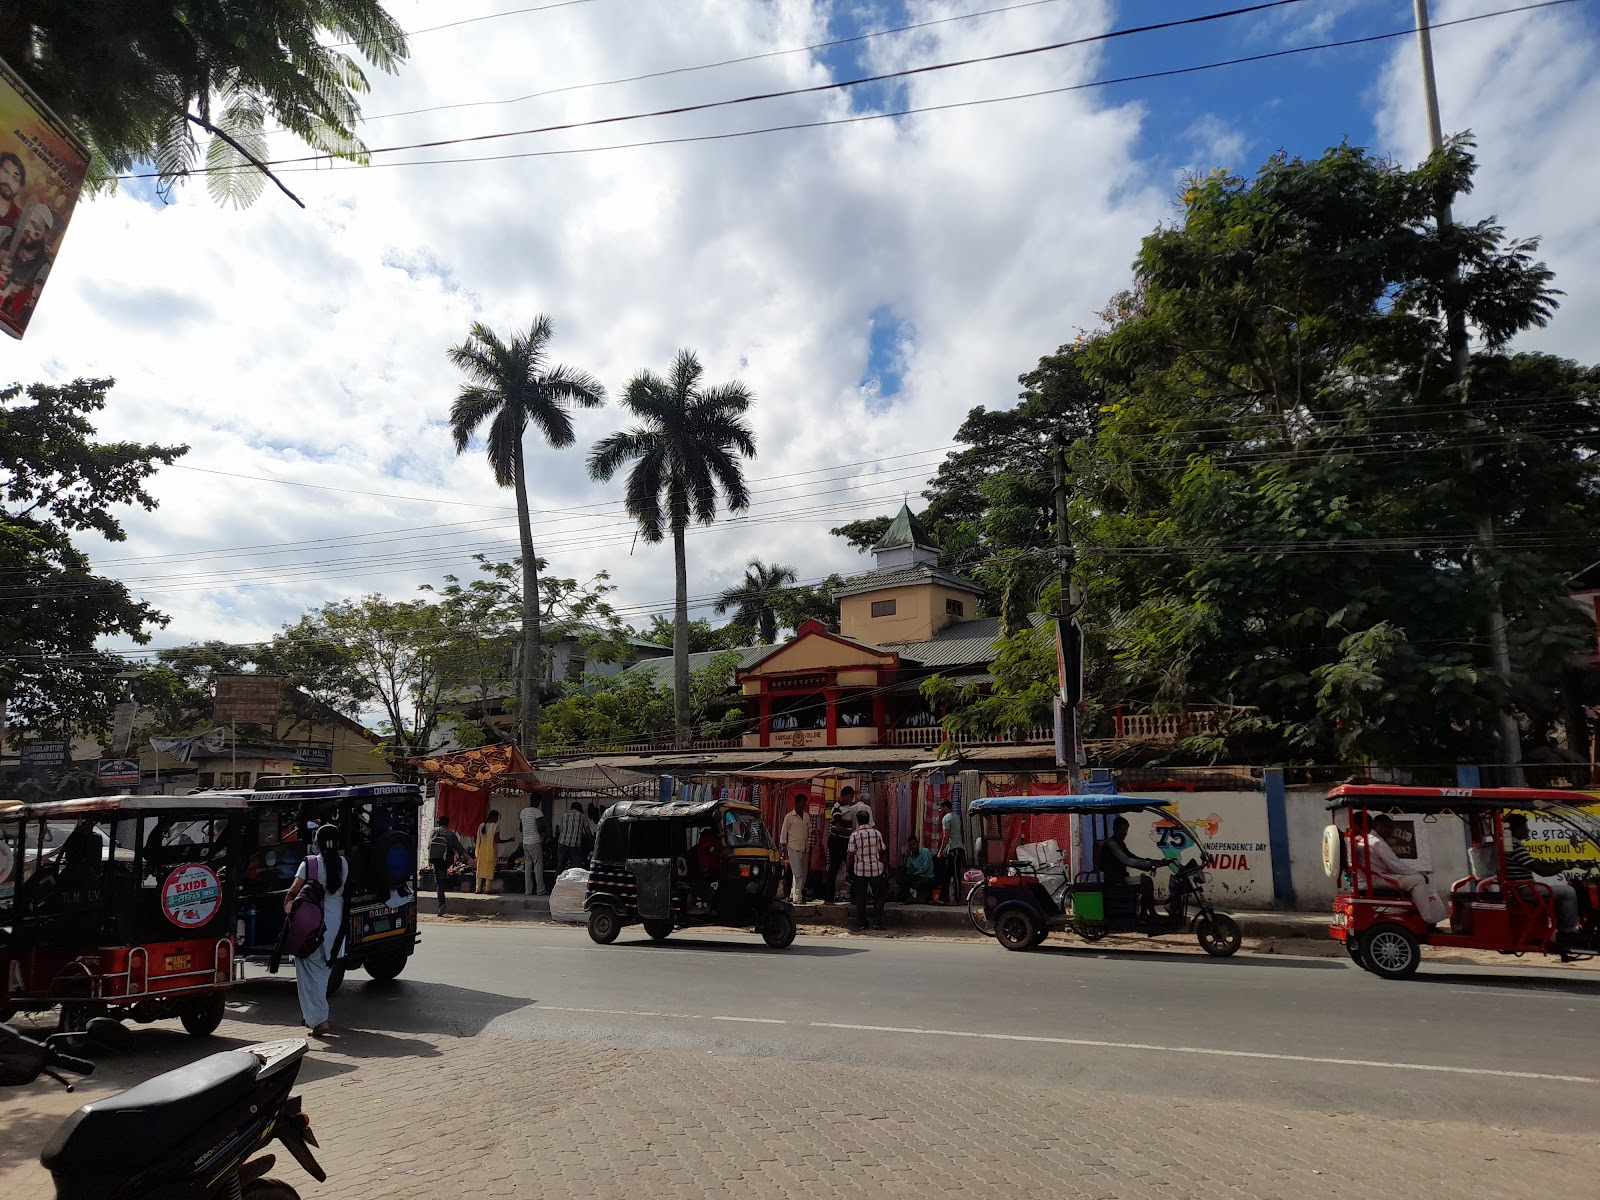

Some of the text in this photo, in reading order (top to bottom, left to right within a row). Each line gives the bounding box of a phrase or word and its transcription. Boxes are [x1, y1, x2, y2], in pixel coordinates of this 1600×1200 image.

[14, 129, 34, 147] AMIT
[374, 786, 407, 795] DABANG
[1440, 788, 1473, 798] Yatri
[249, 792, 290, 800] DABANG
[1156, 826, 1187, 849] 75
[1255, 843, 1267, 851] DAY
[175, 878, 207, 893] EXIDE
